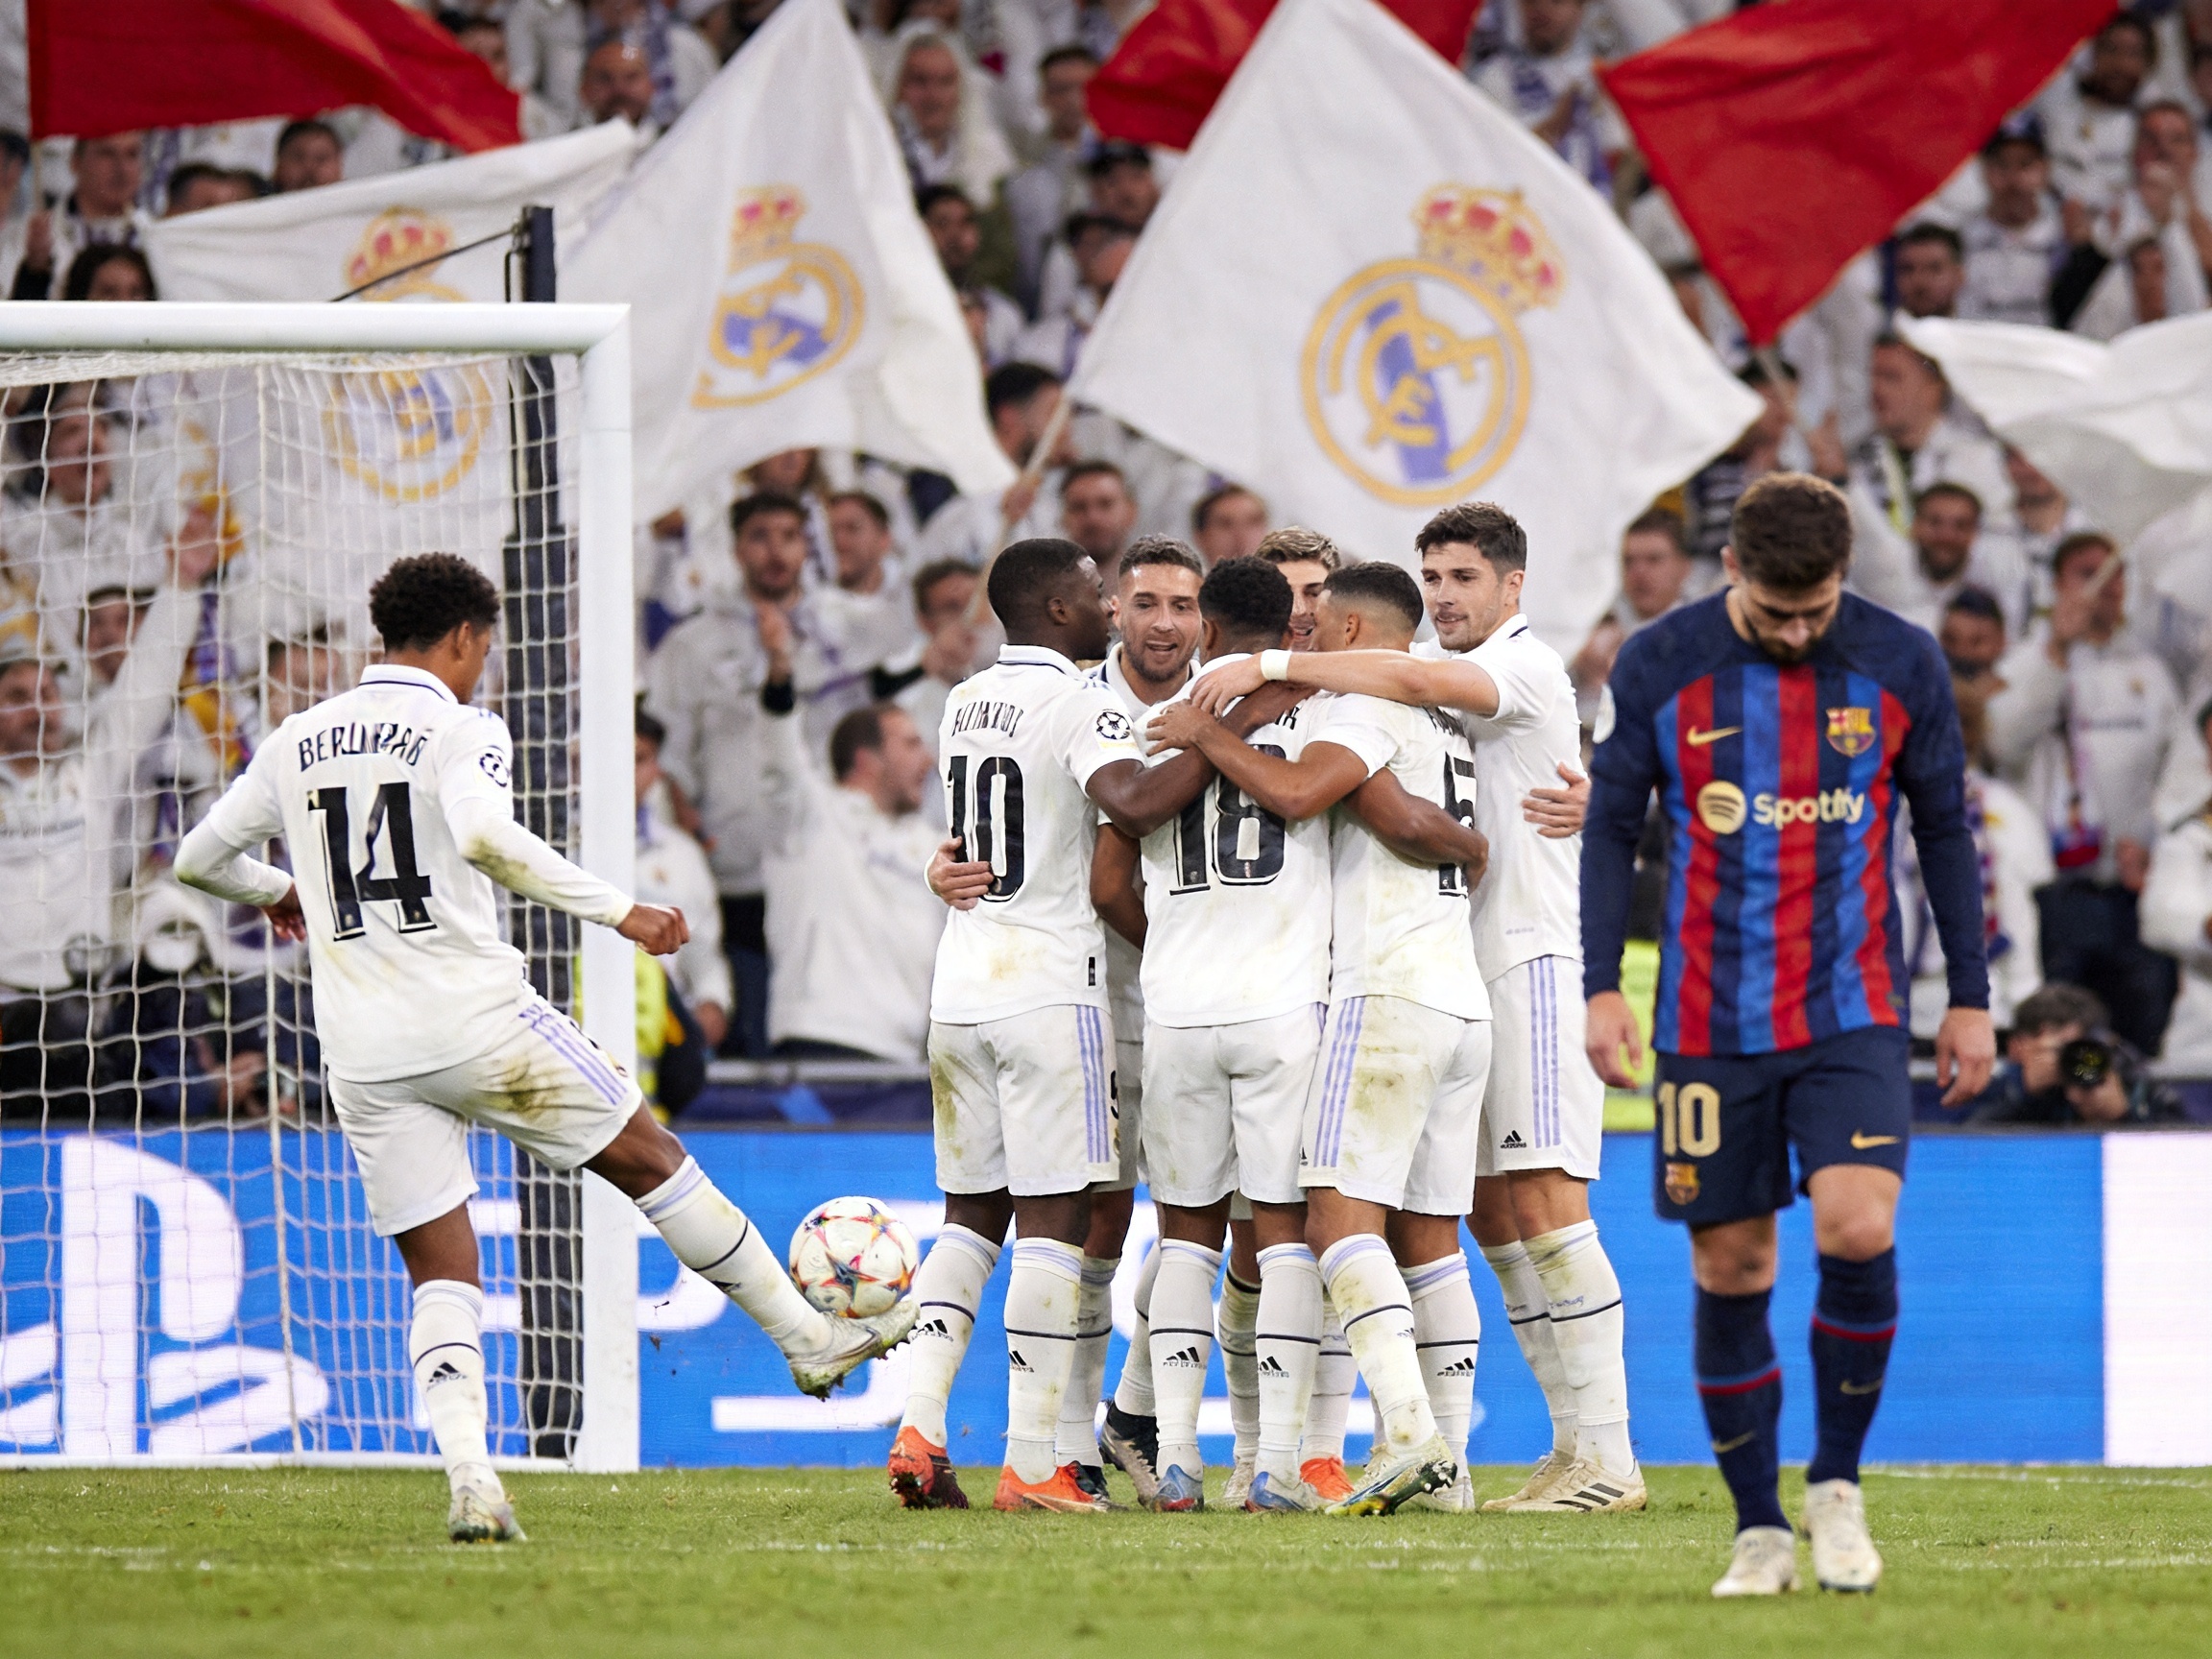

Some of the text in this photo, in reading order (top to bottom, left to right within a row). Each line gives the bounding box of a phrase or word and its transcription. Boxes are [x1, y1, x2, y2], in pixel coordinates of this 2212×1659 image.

[306, 781, 438, 942] 14
[947, 755, 1024, 902] 10
[1752, 786, 1865, 831] Spotify
[1658, 1080, 1721, 1158] 10
